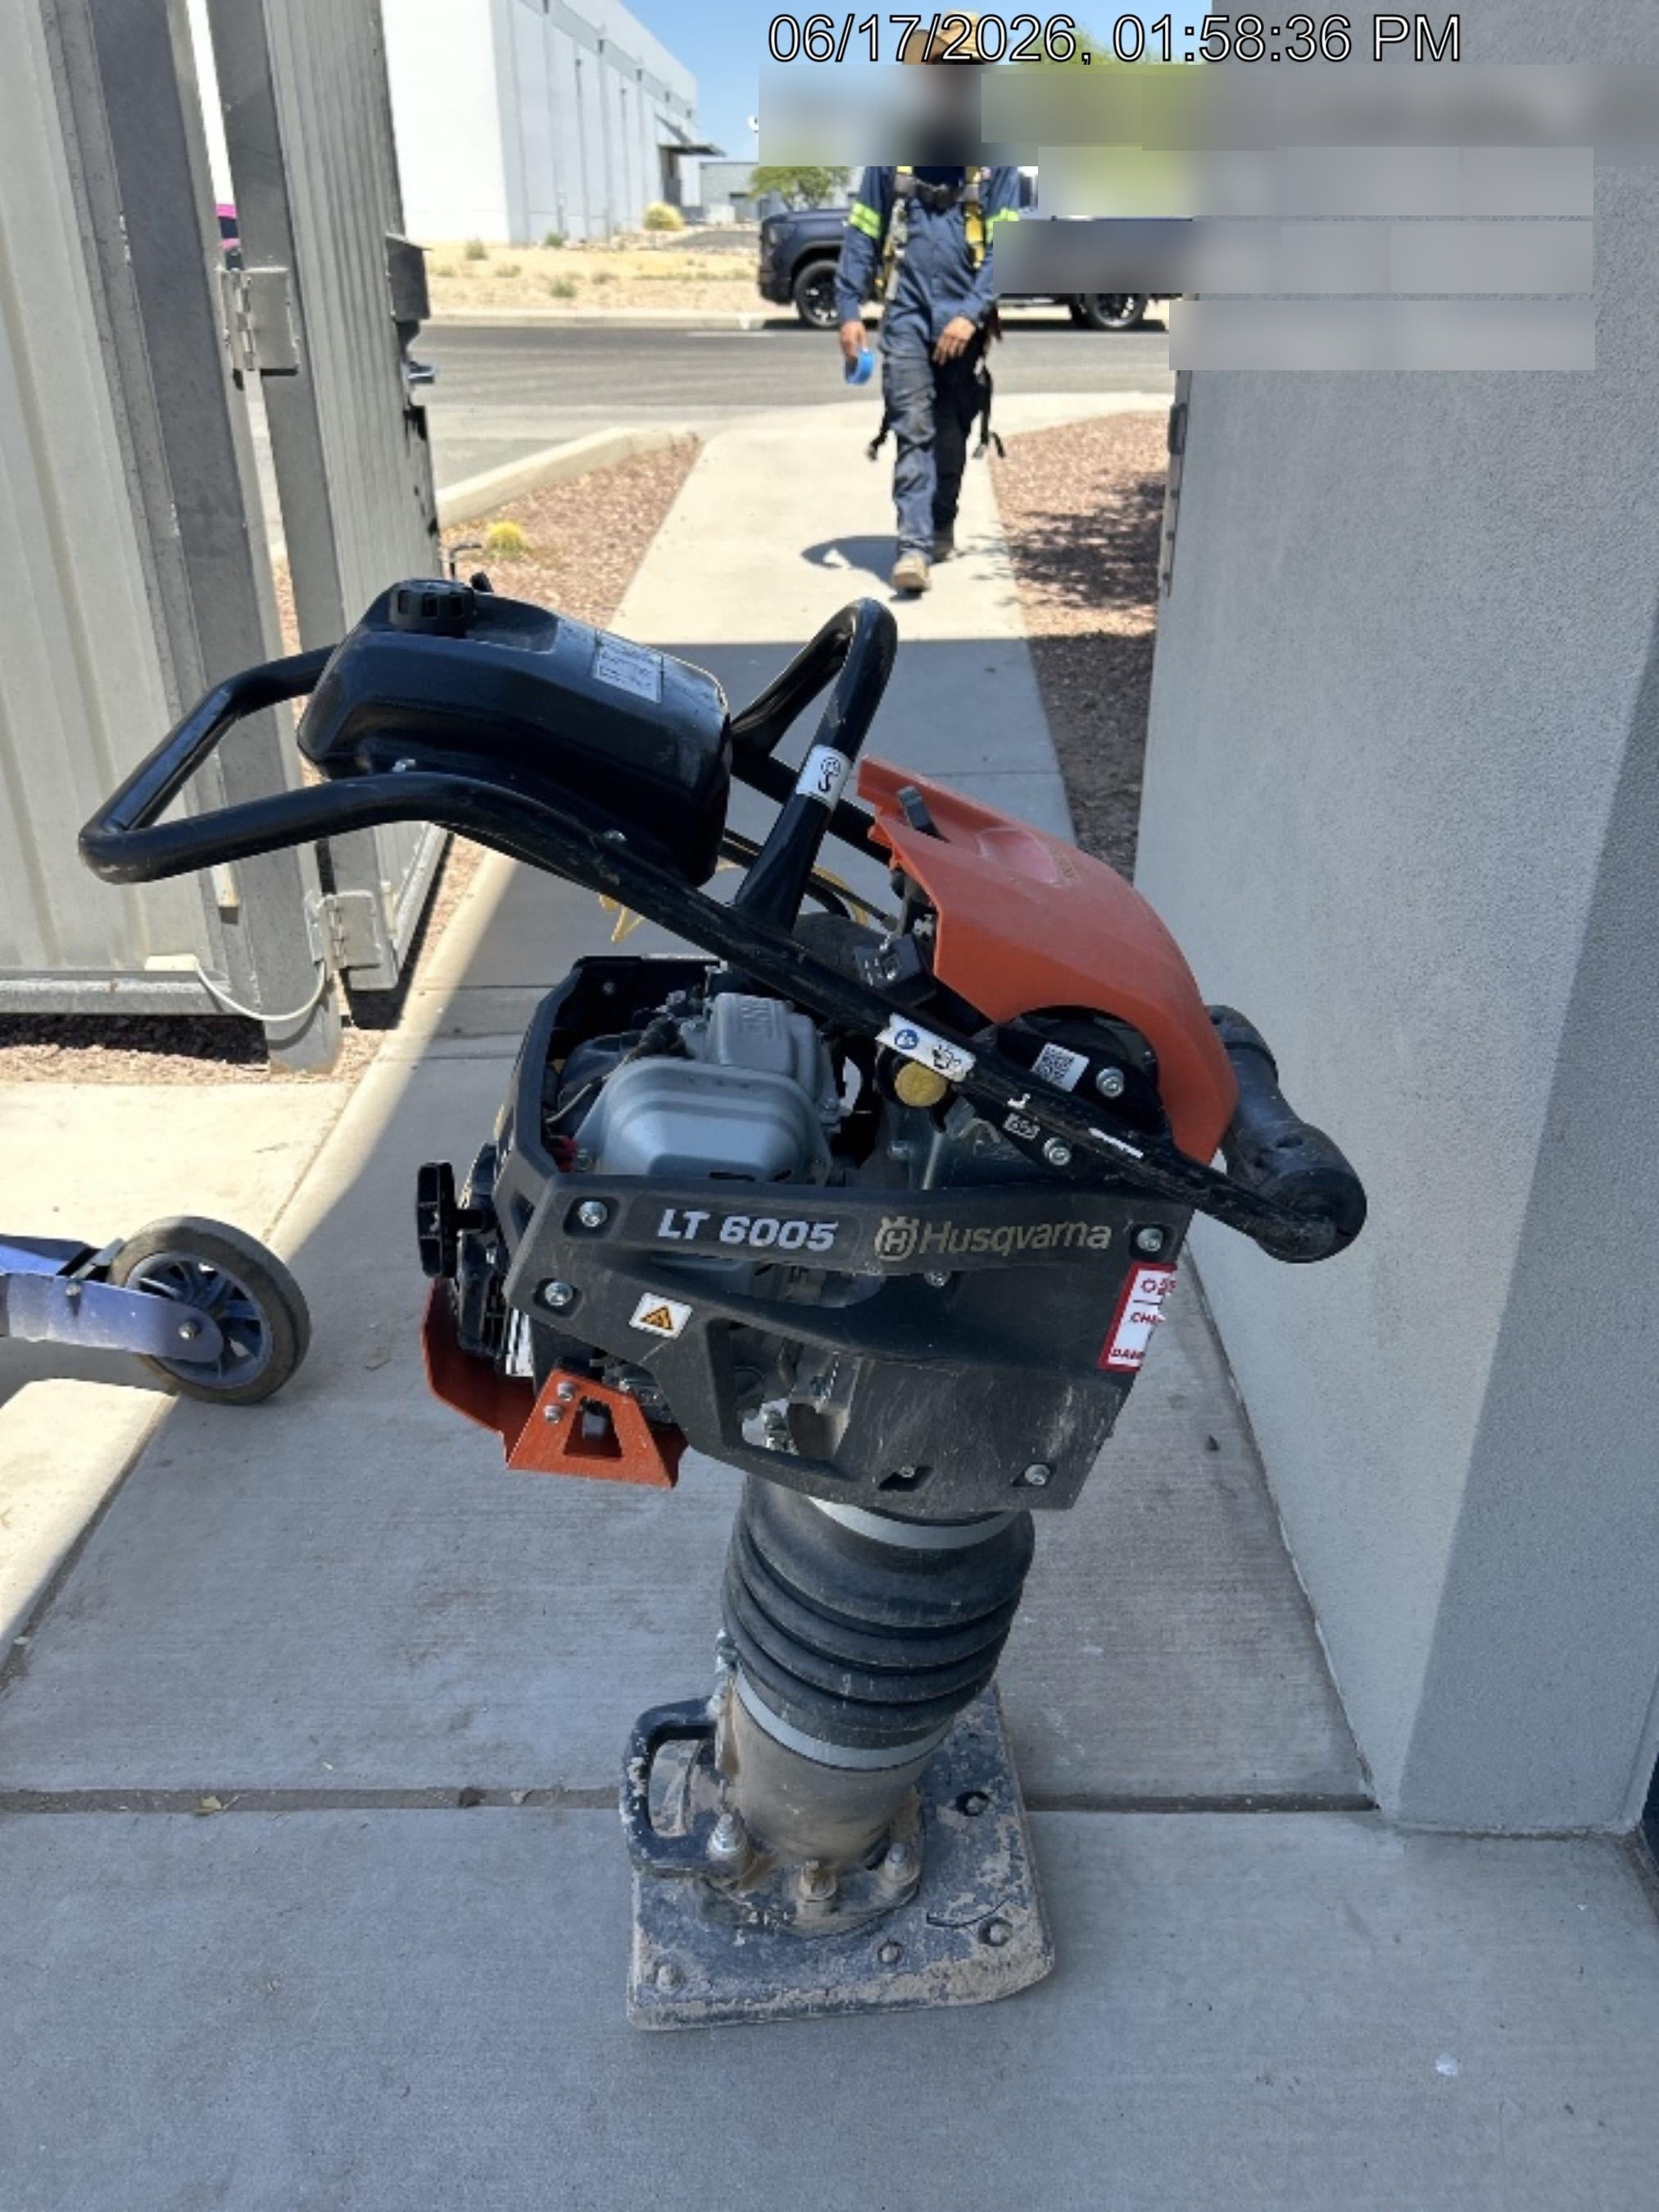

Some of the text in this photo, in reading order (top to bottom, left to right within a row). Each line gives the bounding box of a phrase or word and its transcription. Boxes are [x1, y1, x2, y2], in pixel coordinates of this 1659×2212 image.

[657, 1208, 839, 1252] LT 6005
[918, 1220, 1112, 1257] Husqvarna
